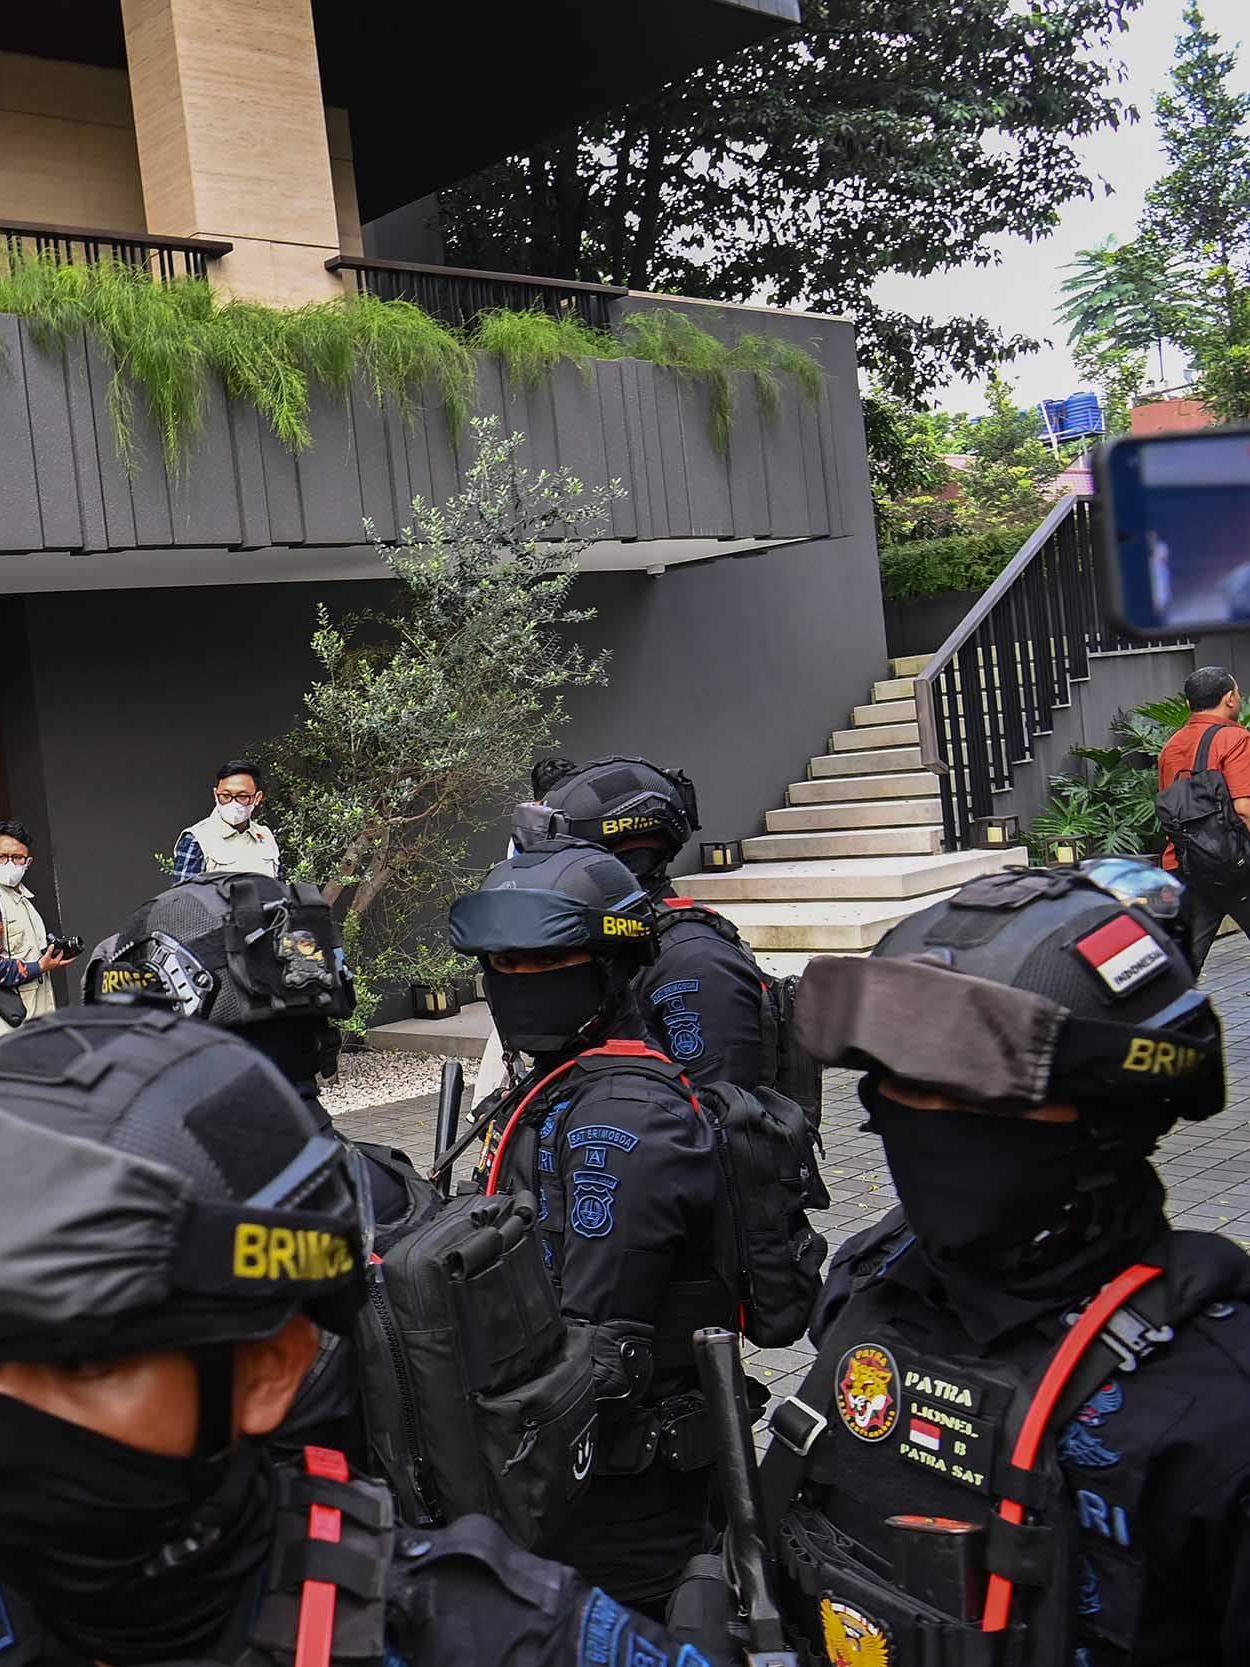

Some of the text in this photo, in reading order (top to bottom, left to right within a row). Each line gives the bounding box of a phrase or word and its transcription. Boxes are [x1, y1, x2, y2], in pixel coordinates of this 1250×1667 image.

[588, 1150, 602, 1165] A
[904, 1371, 973, 1407] PATRA
[911, 1402, 980, 1438] LIONEL
[900, 1443, 985, 1486] PATRA SAT
